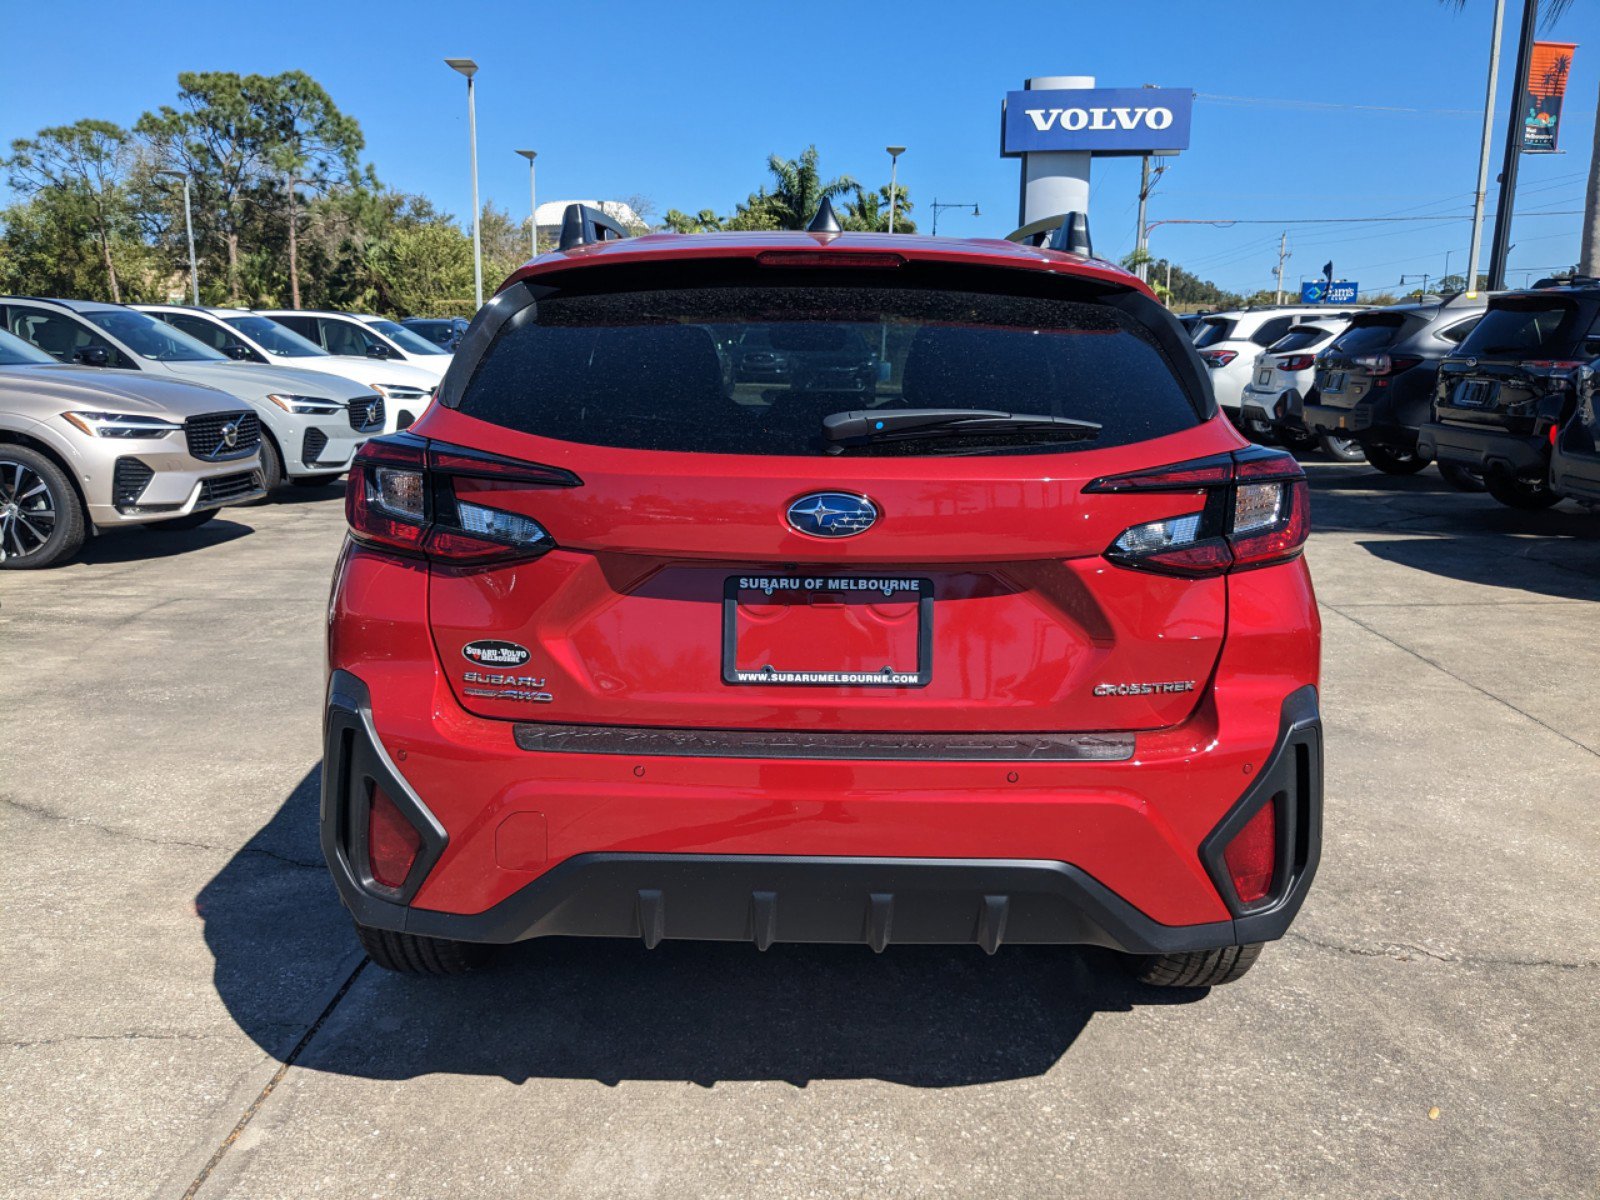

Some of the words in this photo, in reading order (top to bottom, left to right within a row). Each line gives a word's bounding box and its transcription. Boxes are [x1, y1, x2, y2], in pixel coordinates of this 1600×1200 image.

[1025, 107, 1173, 131] VOLVO
[739, 578, 800, 590] SUBARU
[804, 578, 823, 590] OF
[828, 579, 920, 591] MELBOURNE
[463, 672, 546, 687] SUBARU
[737, 673, 918, 684] WWW.SUBARUMELBOURNE.COM
[1093, 681, 1196, 696] CROSSTREK
